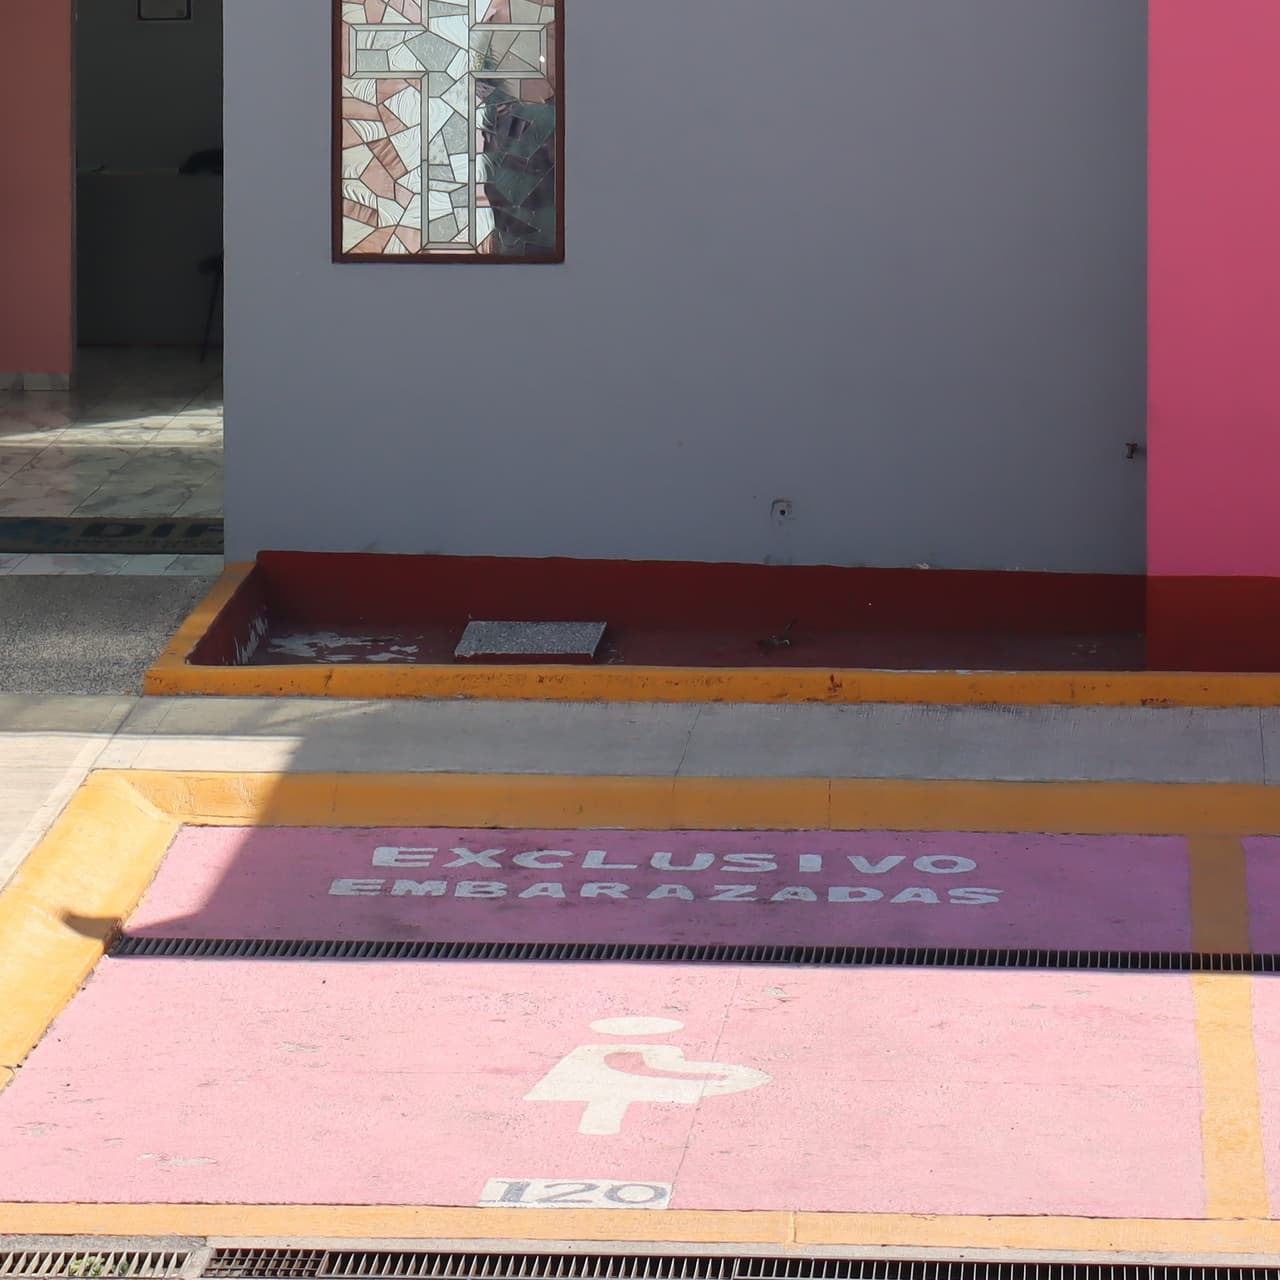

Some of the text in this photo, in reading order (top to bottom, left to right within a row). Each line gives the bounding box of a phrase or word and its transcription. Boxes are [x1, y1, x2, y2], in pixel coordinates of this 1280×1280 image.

[370, 845, 978, 875] EXCLUSIVO
[326, 877, 1006, 907] EMBARAZADAS
[479, 1179, 669, 1205] 120
